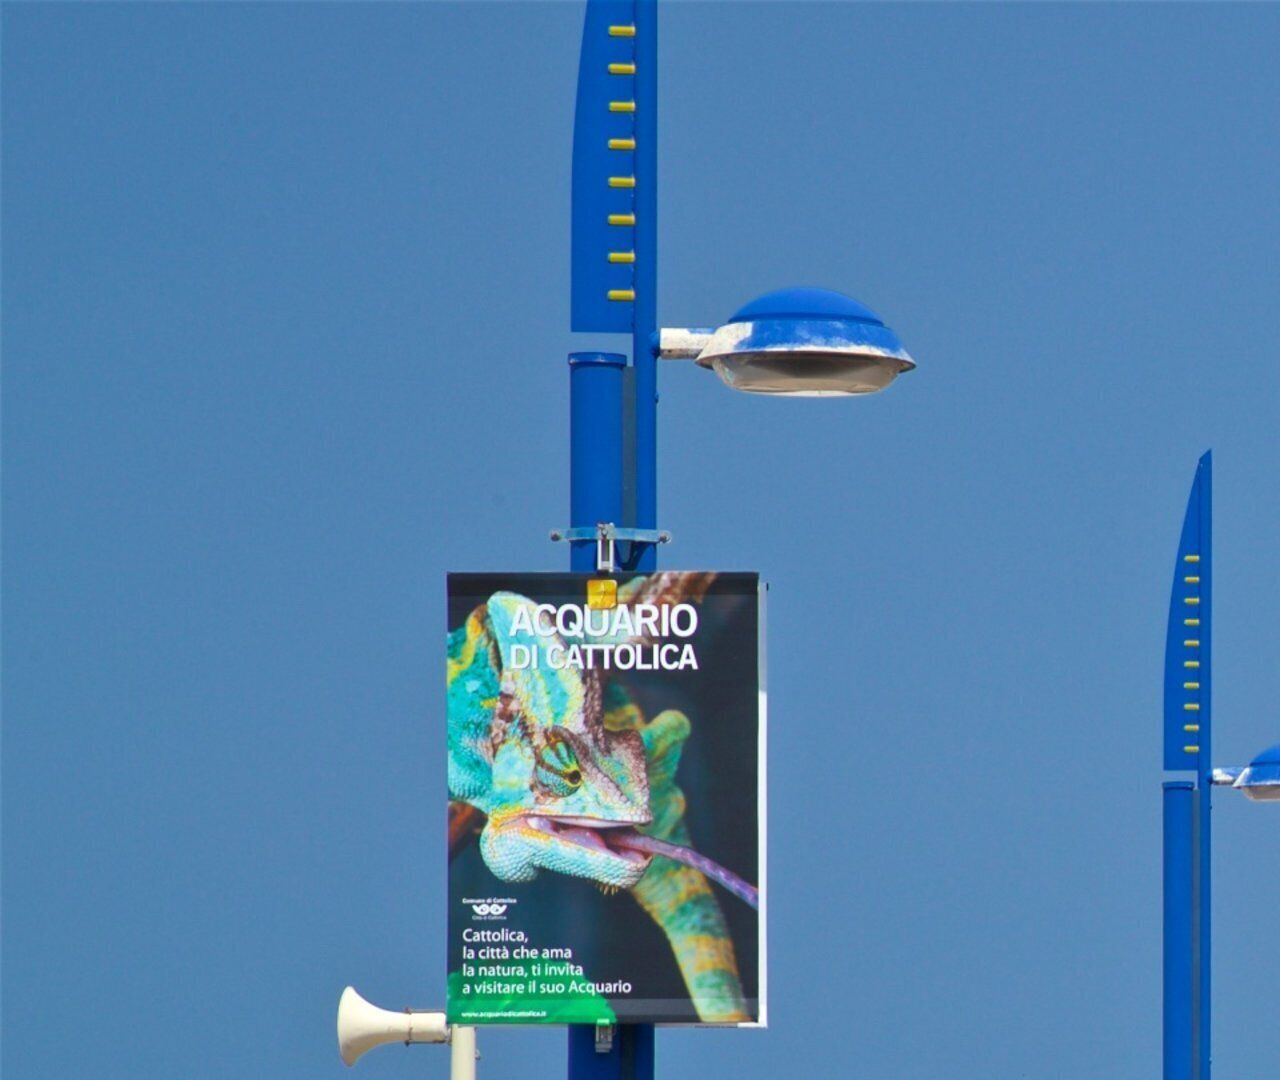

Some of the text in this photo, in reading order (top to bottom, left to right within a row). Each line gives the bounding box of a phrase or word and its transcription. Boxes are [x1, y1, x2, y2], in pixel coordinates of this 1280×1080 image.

[508, 603, 698, 639] ACQUARIO
[509, 643, 699, 671] DI CATTOLICA
[462, 928, 528, 944] Cattolica,
[462, 946, 572, 960] la città che ama
[462, 963, 584, 979] la natura, ti invita
[462, 980, 632, 996] a visitare il suo Acquario
